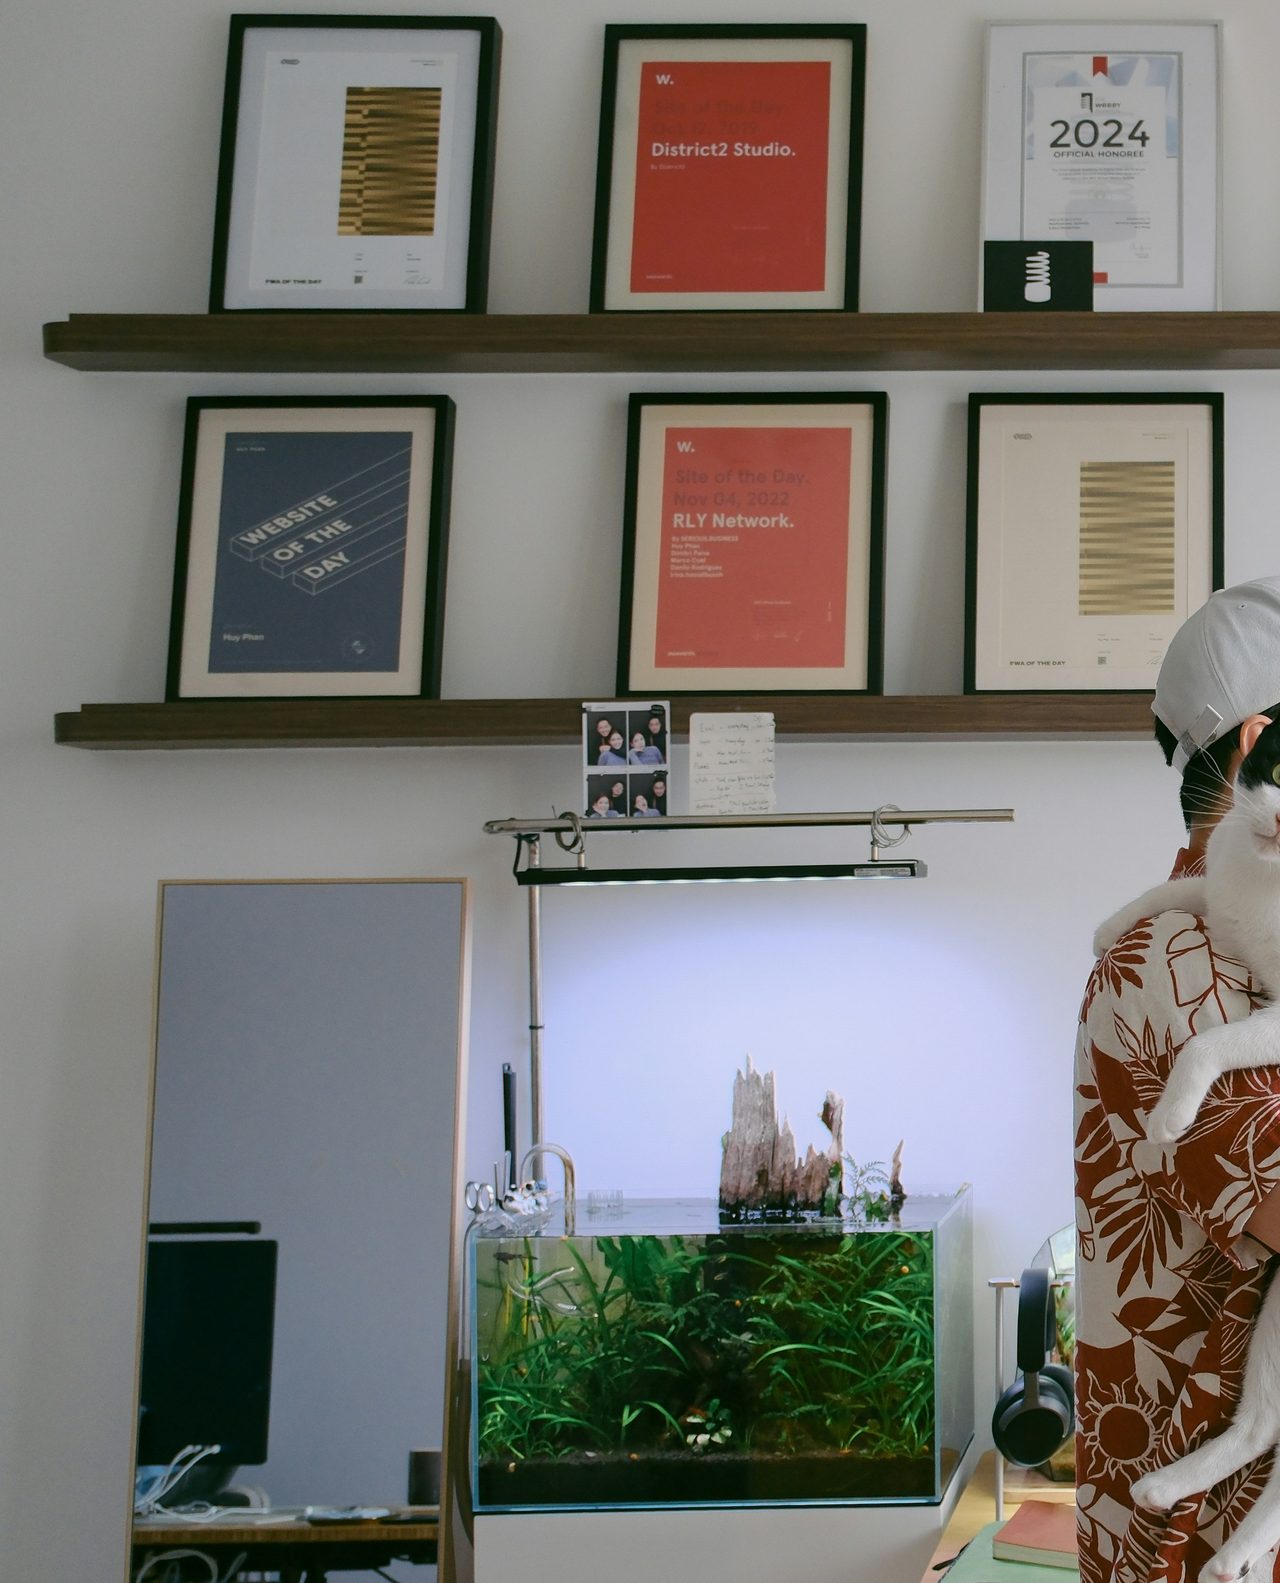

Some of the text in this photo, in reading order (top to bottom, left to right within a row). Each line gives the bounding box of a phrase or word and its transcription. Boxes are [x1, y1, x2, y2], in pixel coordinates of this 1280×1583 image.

[1050, 119, 1150, 148] 2024
[651, 142, 796, 156] District2 Studio.
[1053, 150, 1144, 158] OFFICIAL HONOREE
[676, 441, 696, 453] w.
[676, 470, 810, 486] Site of the Day.
[674, 492, 790, 508] Nov 04, 2022
[239, 494, 338, 546] WEBSITE
[672, 512, 794, 528] RLY Network.
[272, 520, 353, 561] OF THE
[303, 551, 351, 580] DAY
[223, 632, 264, 642] Huy Phan
